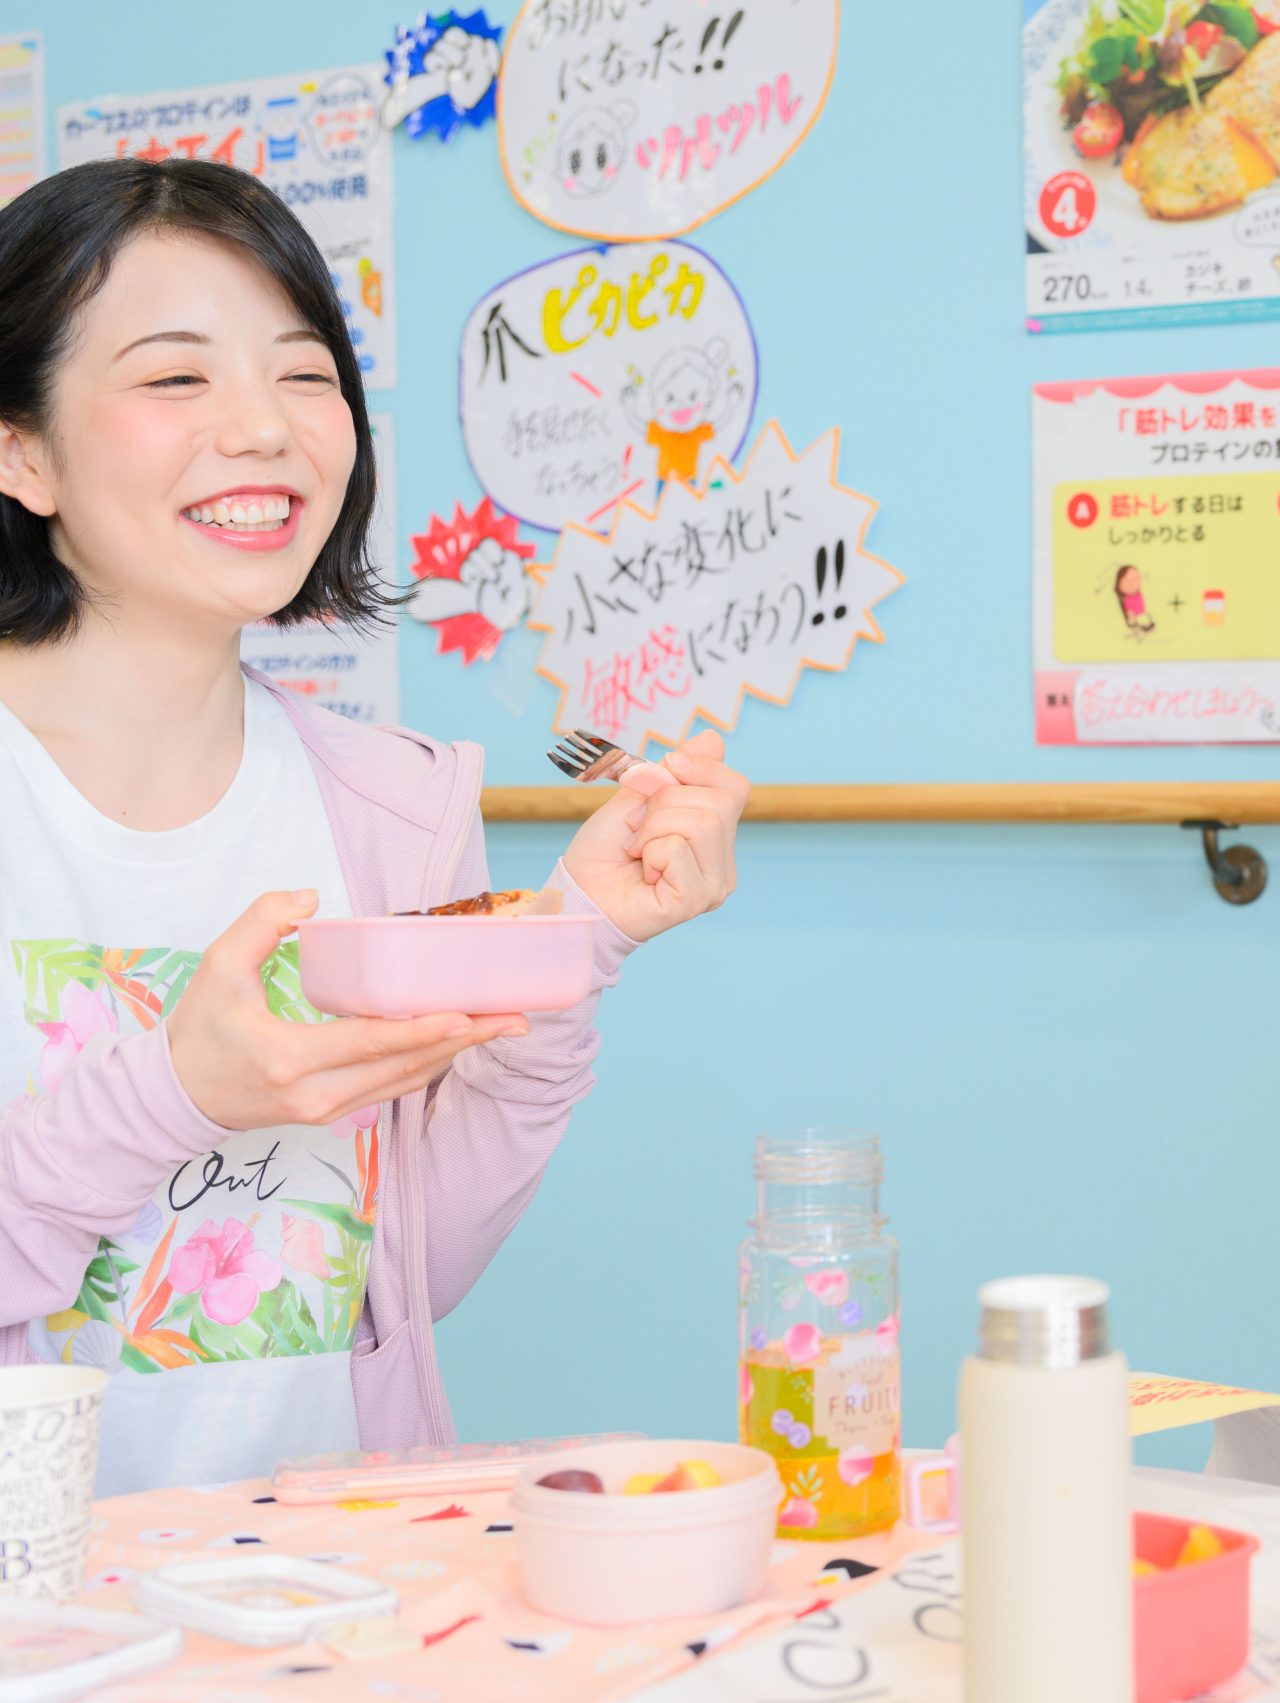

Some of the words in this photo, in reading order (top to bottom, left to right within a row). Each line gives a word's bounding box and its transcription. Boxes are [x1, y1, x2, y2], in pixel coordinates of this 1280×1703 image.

[557, 9, 745, 102] になった!!
[635, 72, 802, 183] ツルツル
[1043, 273, 1091, 302] 270
[1108, 524, 1206, 546] しっかりとる
[1109, 493, 1243, 519] 筋トレする日は
[565, 484, 803, 643] 小さな変化に
[168, 1141, 288, 1212] Out
